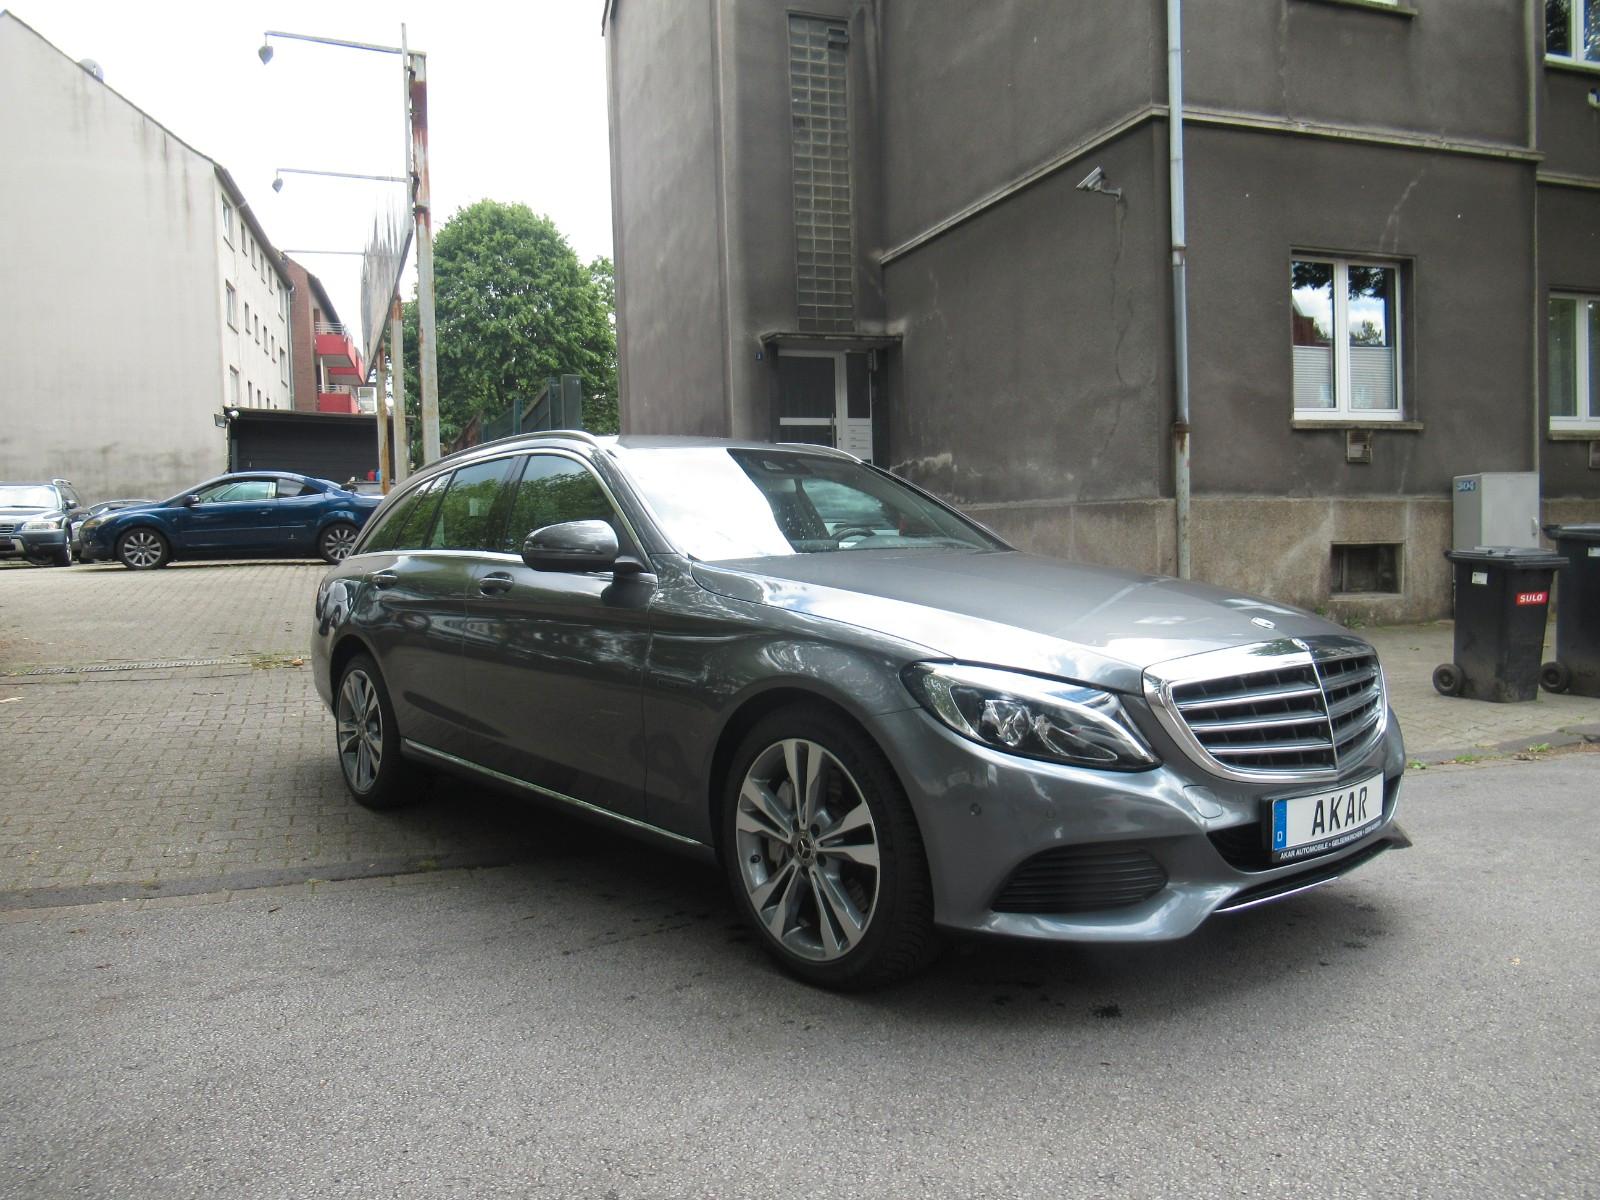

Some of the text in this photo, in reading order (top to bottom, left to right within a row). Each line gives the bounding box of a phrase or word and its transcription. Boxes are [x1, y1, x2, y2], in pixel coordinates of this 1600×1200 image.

[1519, 593, 1543, 603] SULO
[1311, 786, 1368, 837] AKAR
[1277, 831, 1282, 842] D
[1280, 850, 1295, 860] AKAR
[1296, 842, 1328, 855] AUTOMOBILE
